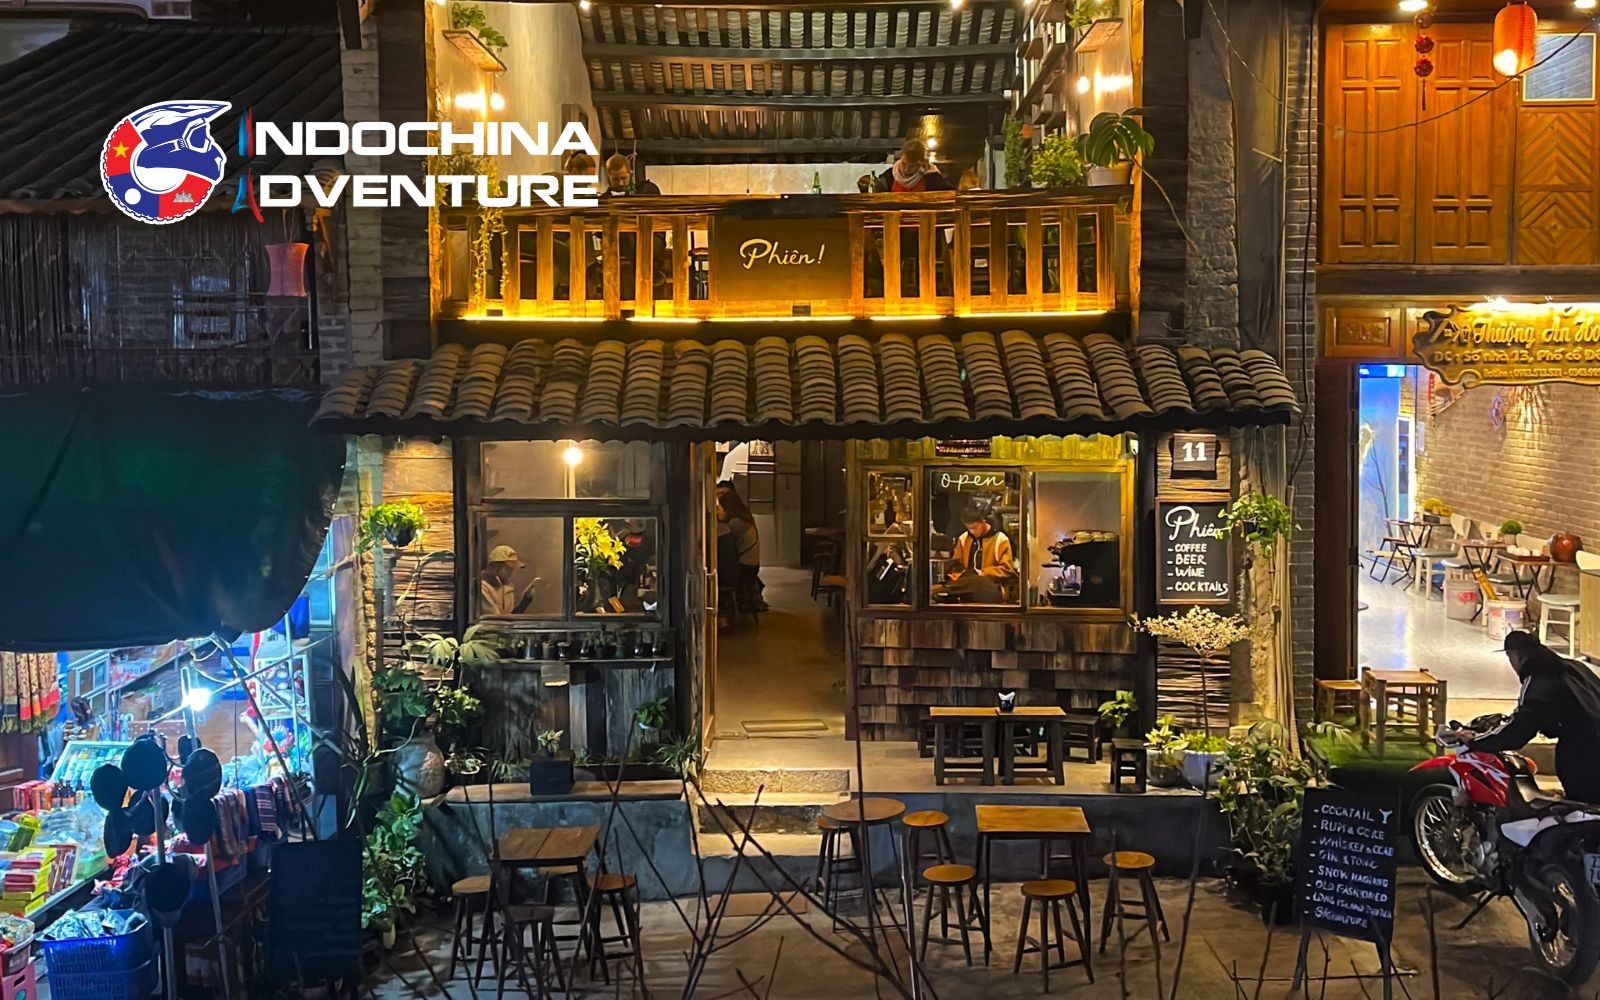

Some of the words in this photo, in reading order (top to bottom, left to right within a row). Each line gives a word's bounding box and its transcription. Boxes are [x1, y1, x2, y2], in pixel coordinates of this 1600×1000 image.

[1182, 442, 1208, 462] 11
[941, 473, 1004, 492] open
[1174, 544, 1208, 553] COFFEE
[1175, 554, 1207, 565] BEER
